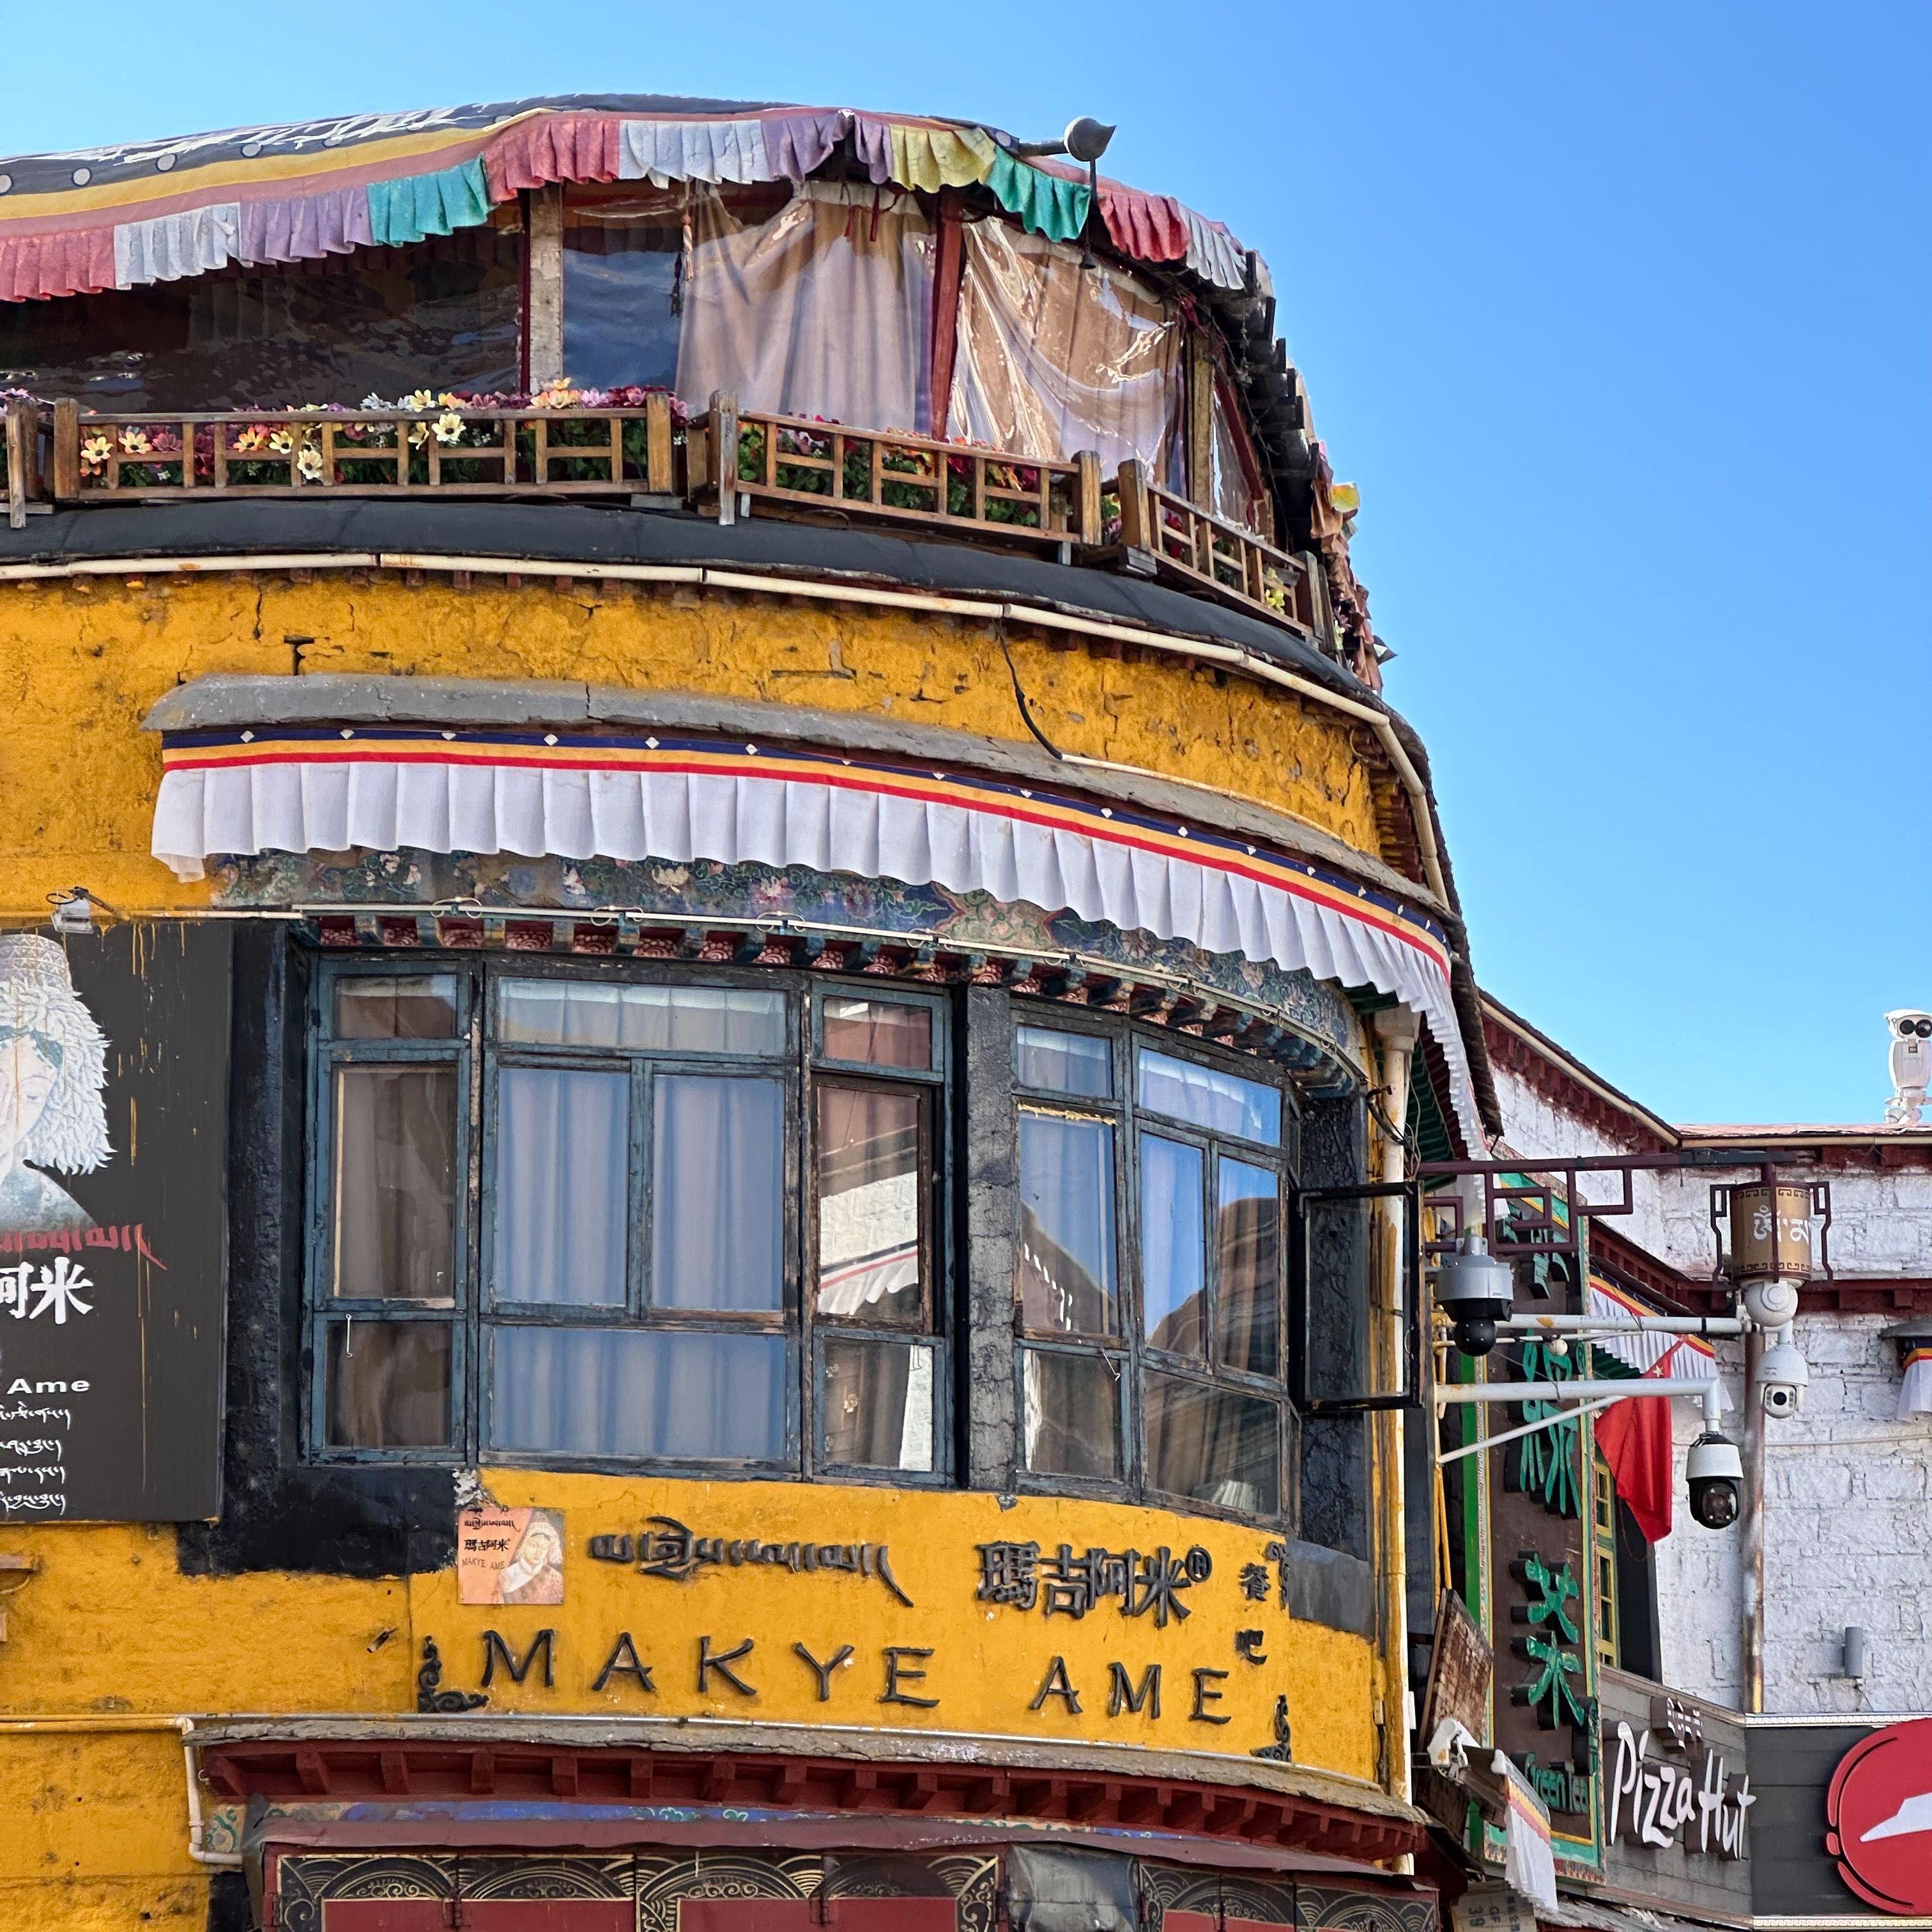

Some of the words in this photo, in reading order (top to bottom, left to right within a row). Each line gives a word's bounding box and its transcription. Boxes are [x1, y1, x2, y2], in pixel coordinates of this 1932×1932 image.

[6, 1378, 90, 1395] Ame
[480, 1629, 940, 1708] MAKYE
[1027, 1655, 1231, 1724] AME
[1611, 1721, 1696, 1848] Pizza
[1698, 1749, 1756, 1860] Hut
